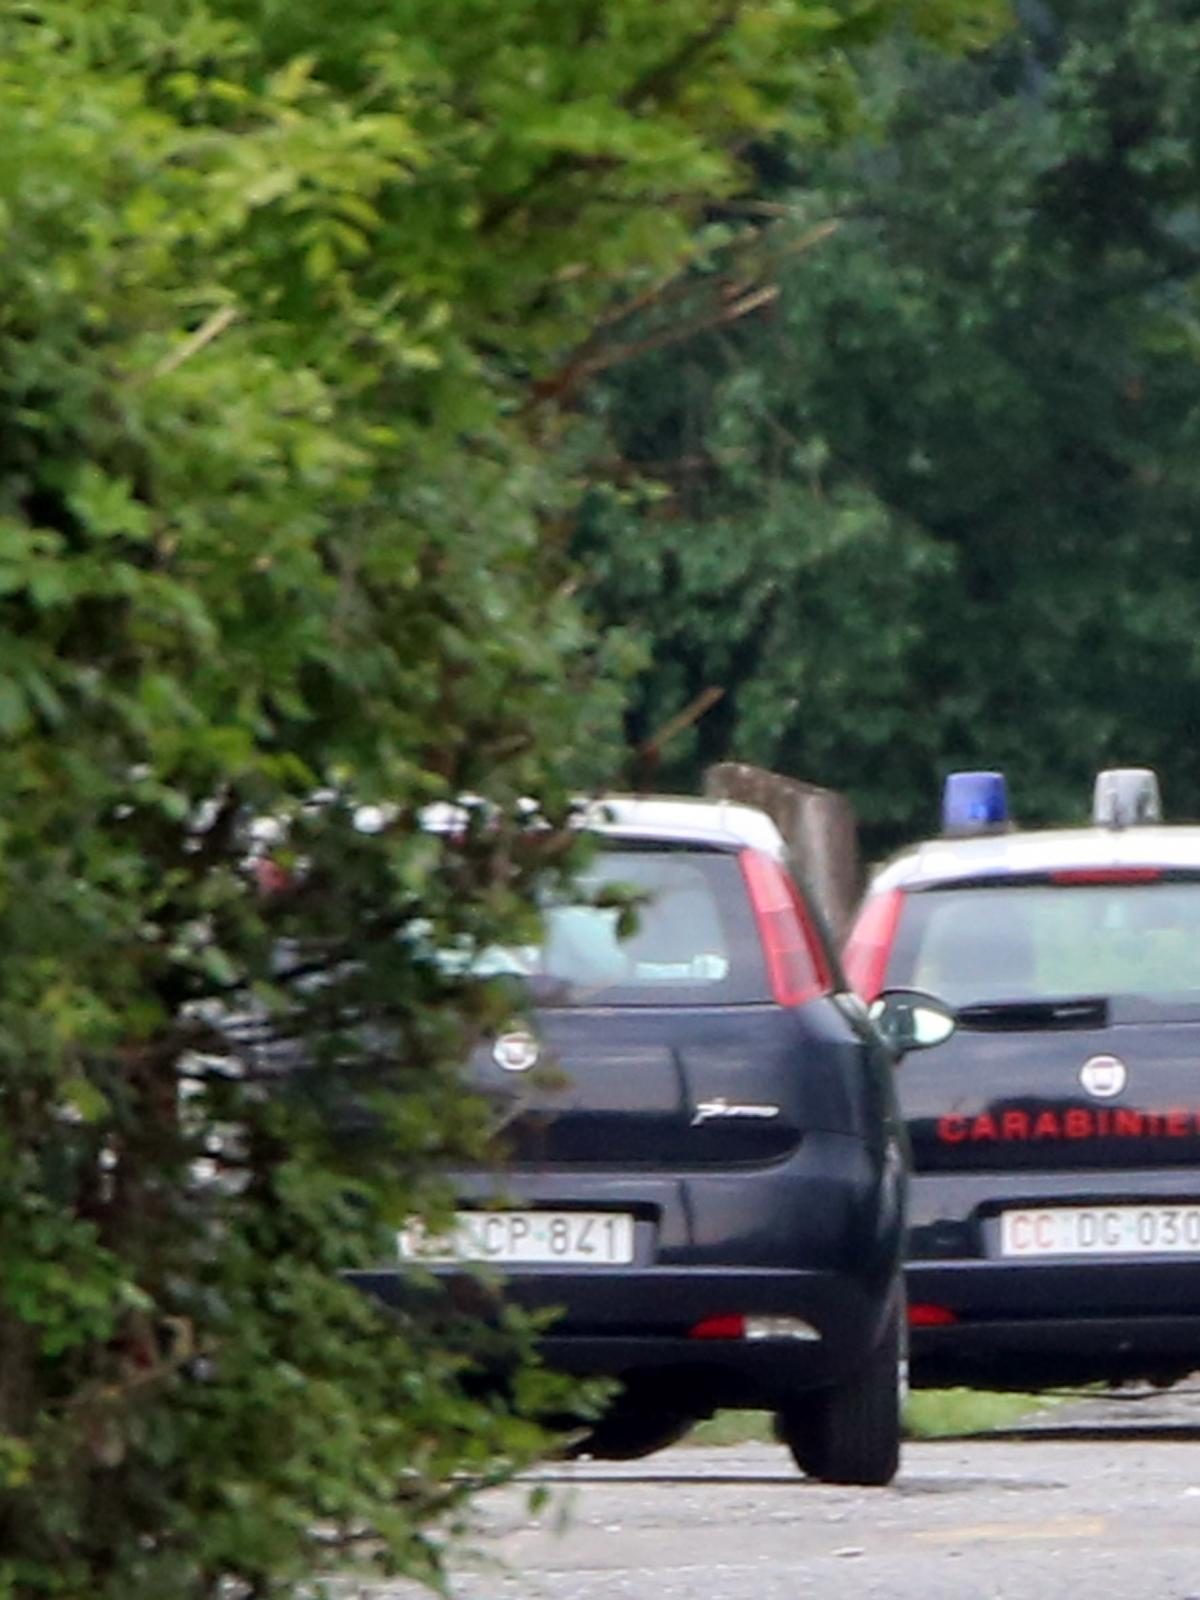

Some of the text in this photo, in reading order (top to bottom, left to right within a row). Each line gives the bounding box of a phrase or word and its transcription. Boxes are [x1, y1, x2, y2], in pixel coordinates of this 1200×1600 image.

[481, 1216, 531, 1257] CP
[548, 1217, 618, 1260] 841
[1010, 1214, 1055, 1250] CC
[1077, 1212, 1120, 1248] DG
